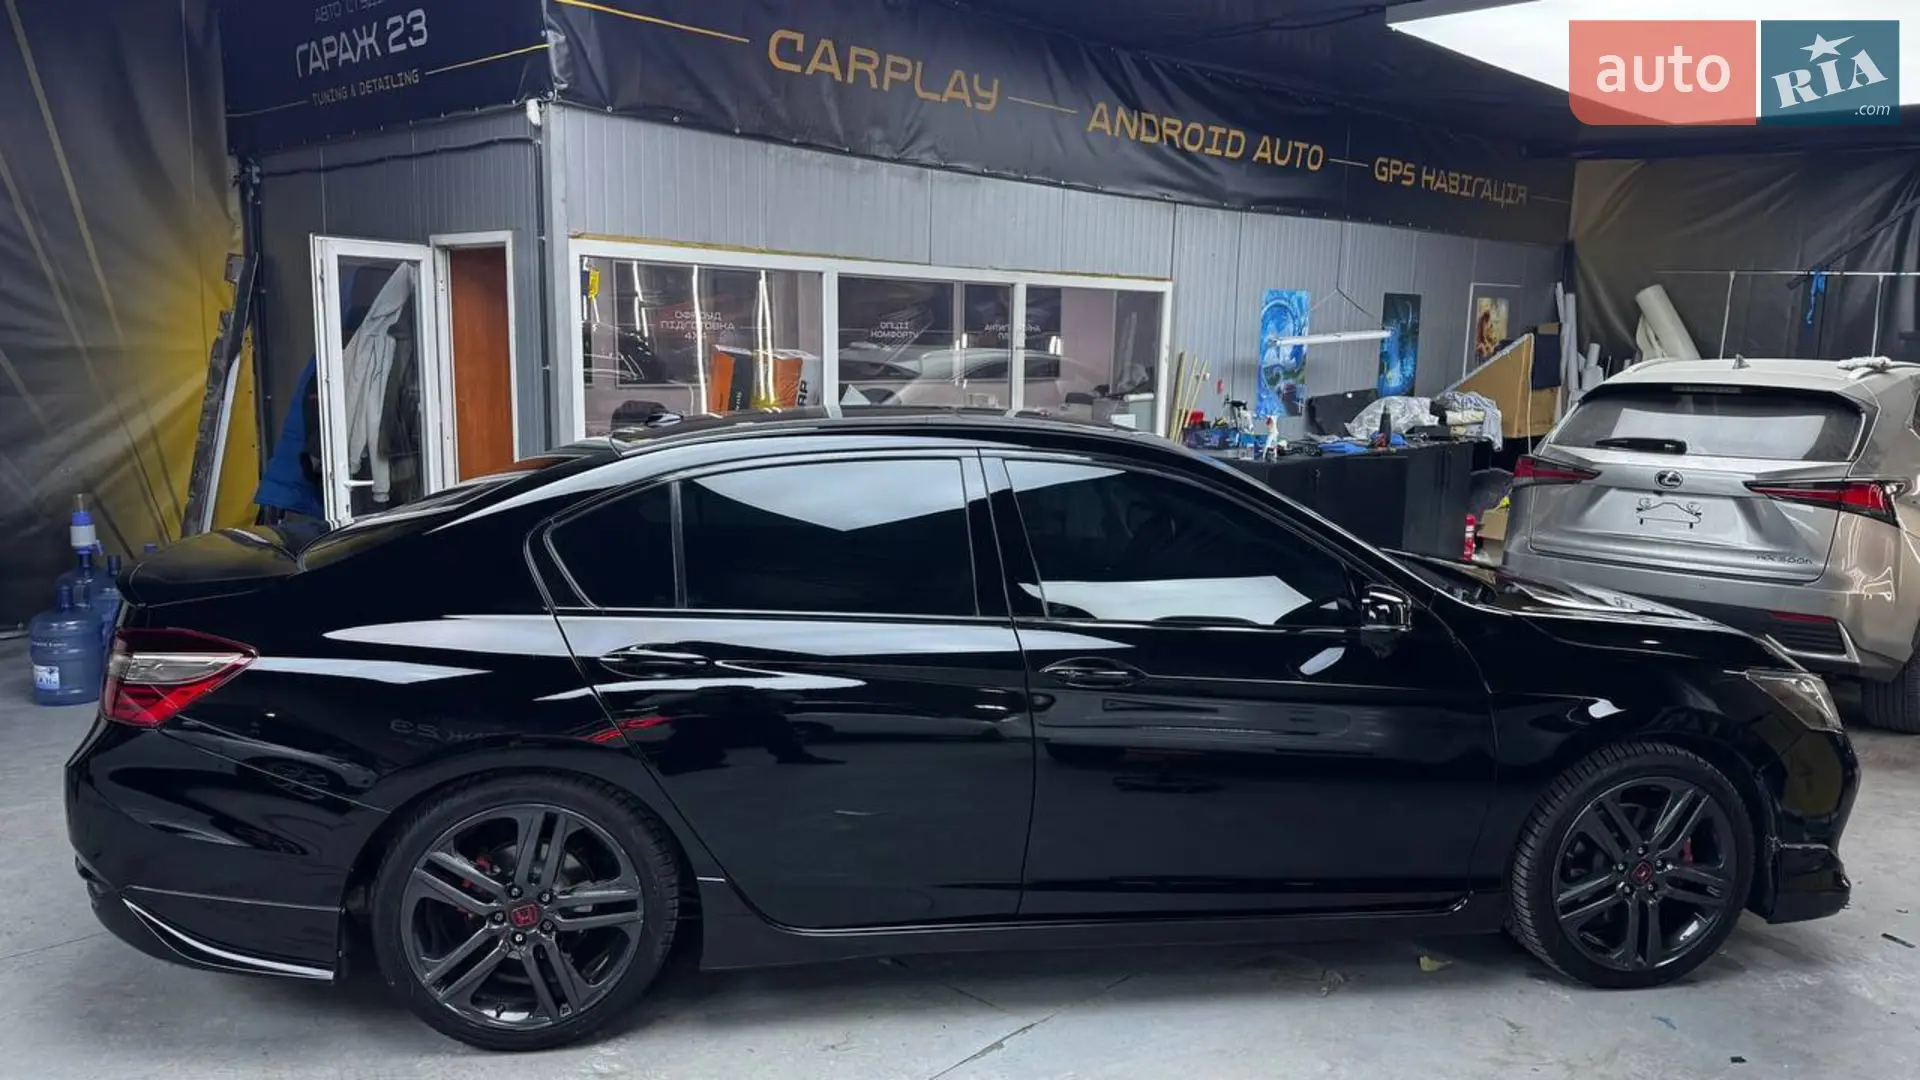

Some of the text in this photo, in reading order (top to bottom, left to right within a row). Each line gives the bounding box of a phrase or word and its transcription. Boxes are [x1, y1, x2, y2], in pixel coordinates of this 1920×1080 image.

[296, 8, 428, 78] ГАРАЖ 23
[768, 29, 999, 112] CARPLAY
[312, 86, 348, 106] TUNING
[359, 68, 420, 96] DETAILING
[1087, 101, 1324, 171] ANDROID AUTO
[1374, 157, 1528, 207] GPS НАВІГАЦІЯ
